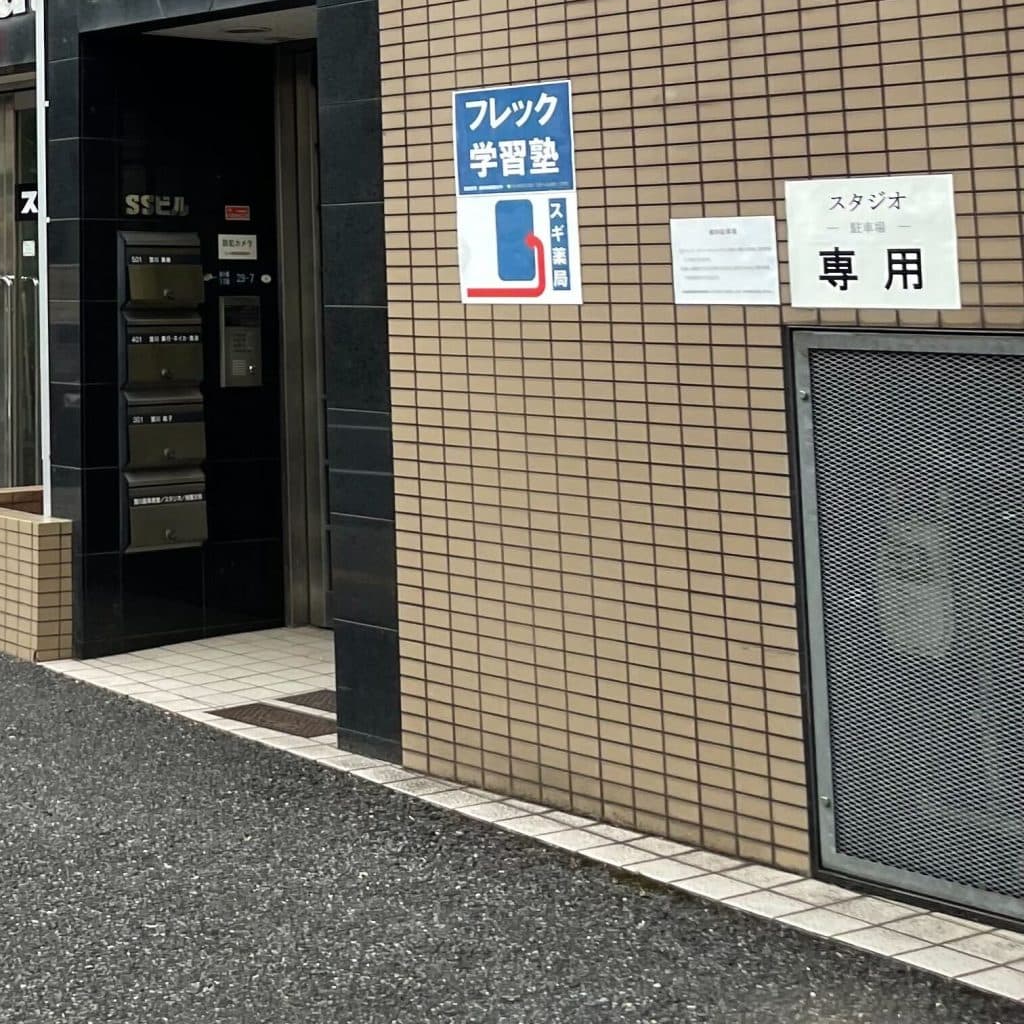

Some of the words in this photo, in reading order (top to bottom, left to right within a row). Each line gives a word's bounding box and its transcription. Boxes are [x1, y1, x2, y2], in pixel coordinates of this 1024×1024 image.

[465, 92, 558, 131] フレック
[469, 136, 560, 179] 学習塾
[125, 194, 190, 216] SSビル
[829, 191, 907, 212] スタジオ
[550, 202, 569, 288] スギ薬局
